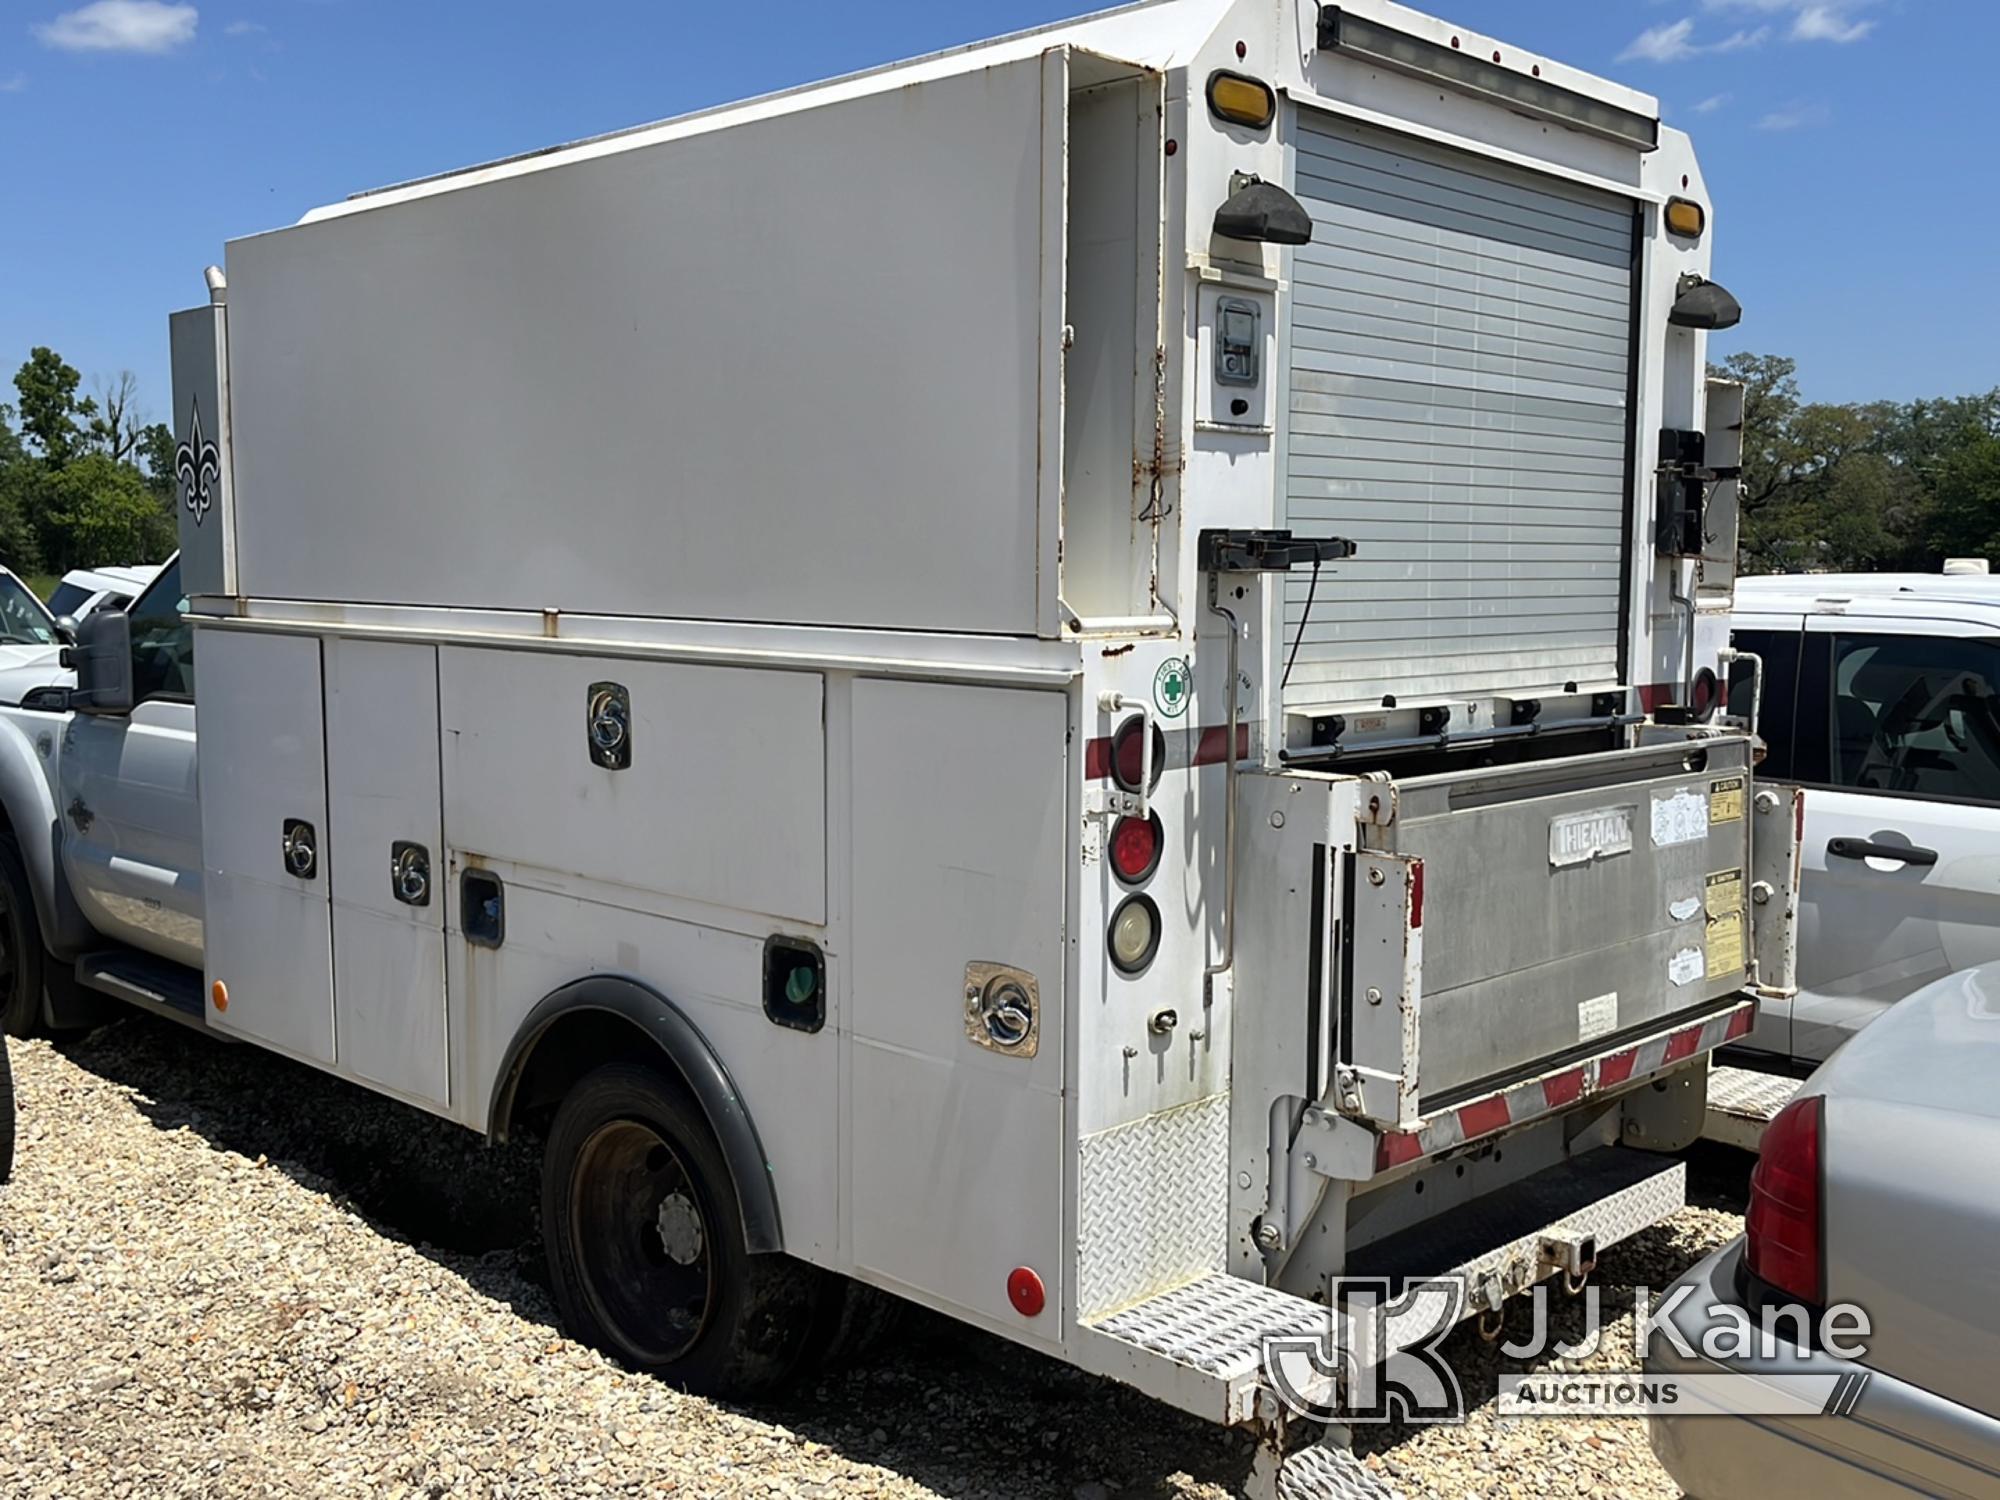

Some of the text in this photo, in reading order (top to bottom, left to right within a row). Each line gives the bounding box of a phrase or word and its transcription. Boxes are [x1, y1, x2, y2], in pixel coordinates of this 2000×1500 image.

[1157, 662, 1176, 680] FIRST
[1167, 704, 1178, 713] KIT
[1555, 815, 1628, 853] THIEMAN
